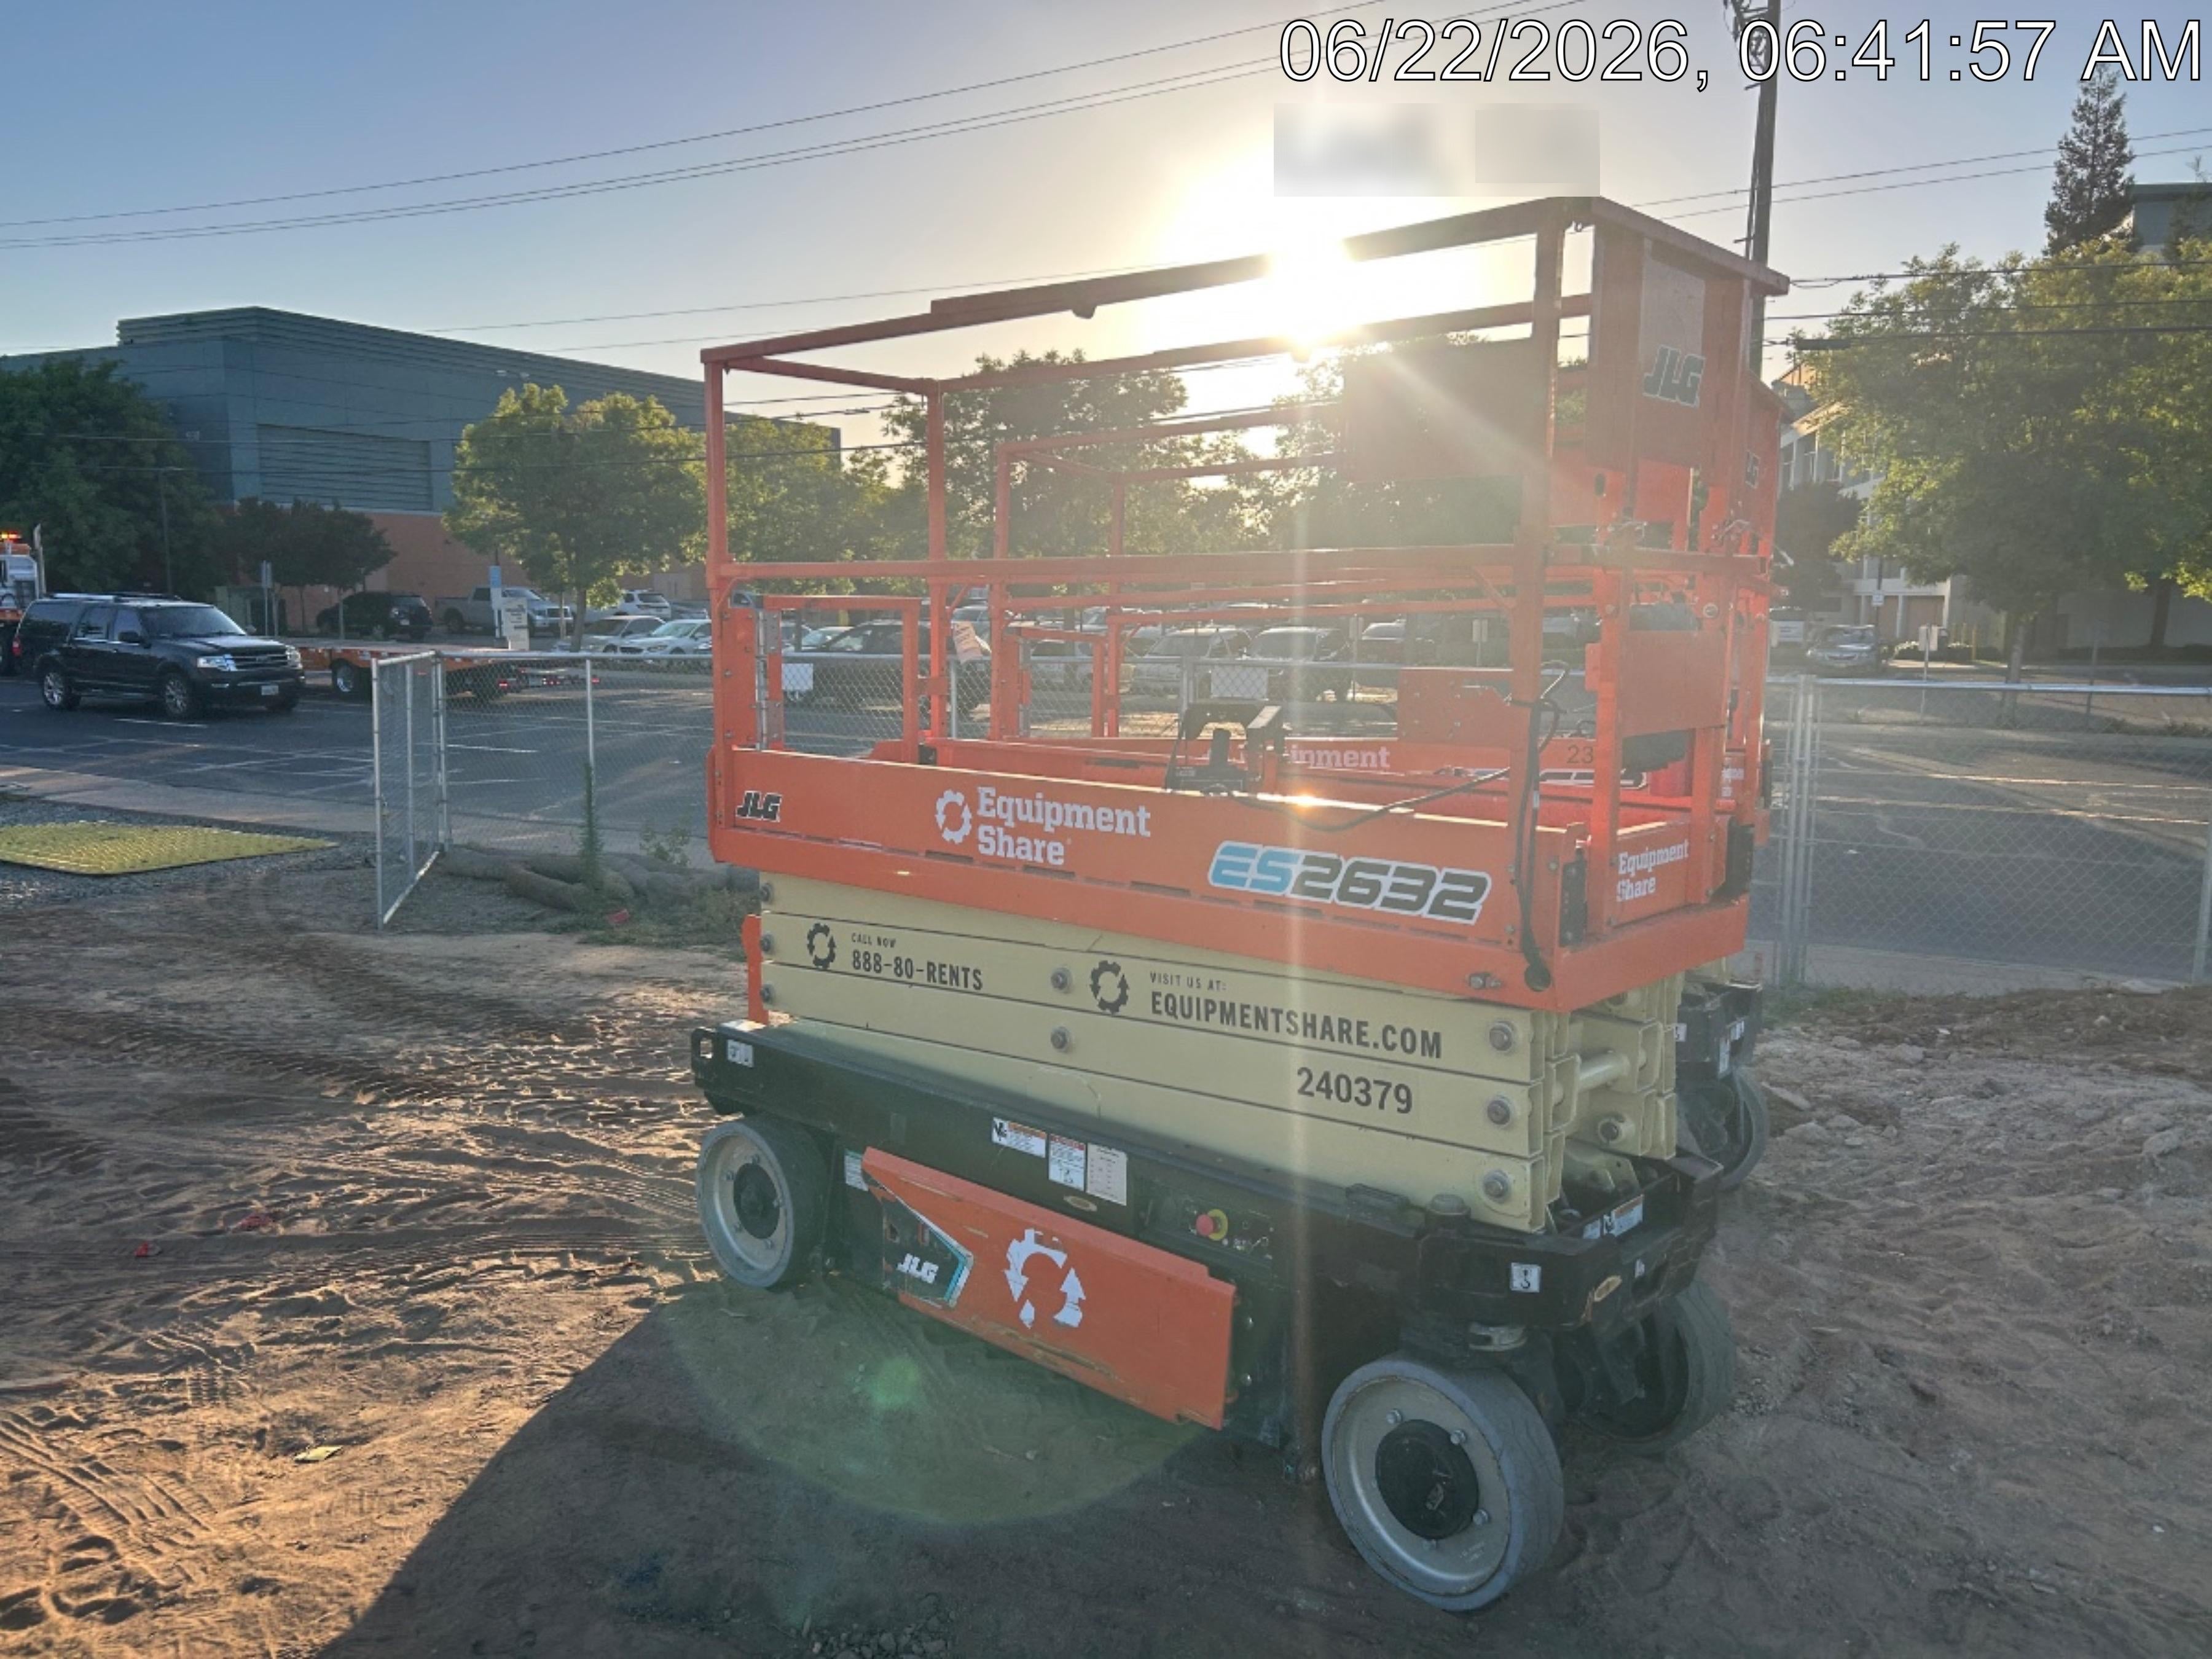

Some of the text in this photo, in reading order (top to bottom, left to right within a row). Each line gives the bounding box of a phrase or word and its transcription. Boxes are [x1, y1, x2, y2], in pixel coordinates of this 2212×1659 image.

[1642, 345, 1706, 408] JLG
[737, 790, 782, 822] JLG
[976, 786, 1151, 837] Equipment
[977, 825, 1065, 866] Share
[1618, 838, 1689, 877] Equipment
[1208, 840, 1492, 925] ES2632
[1616, 877, 1656, 902] Share
[852, 932, 896, 948] CALL NOW
[852, 949, 982, 990] 888-80-RENTS
[1150, 972, 1226, 991] VISIT US AT:
[1151, 991, 1441, 1059] EQUIPMENTSHARE.COM
[1296, 1067, 1413, 1114] 240379
[896, 1253, 939, 1284] JLG
